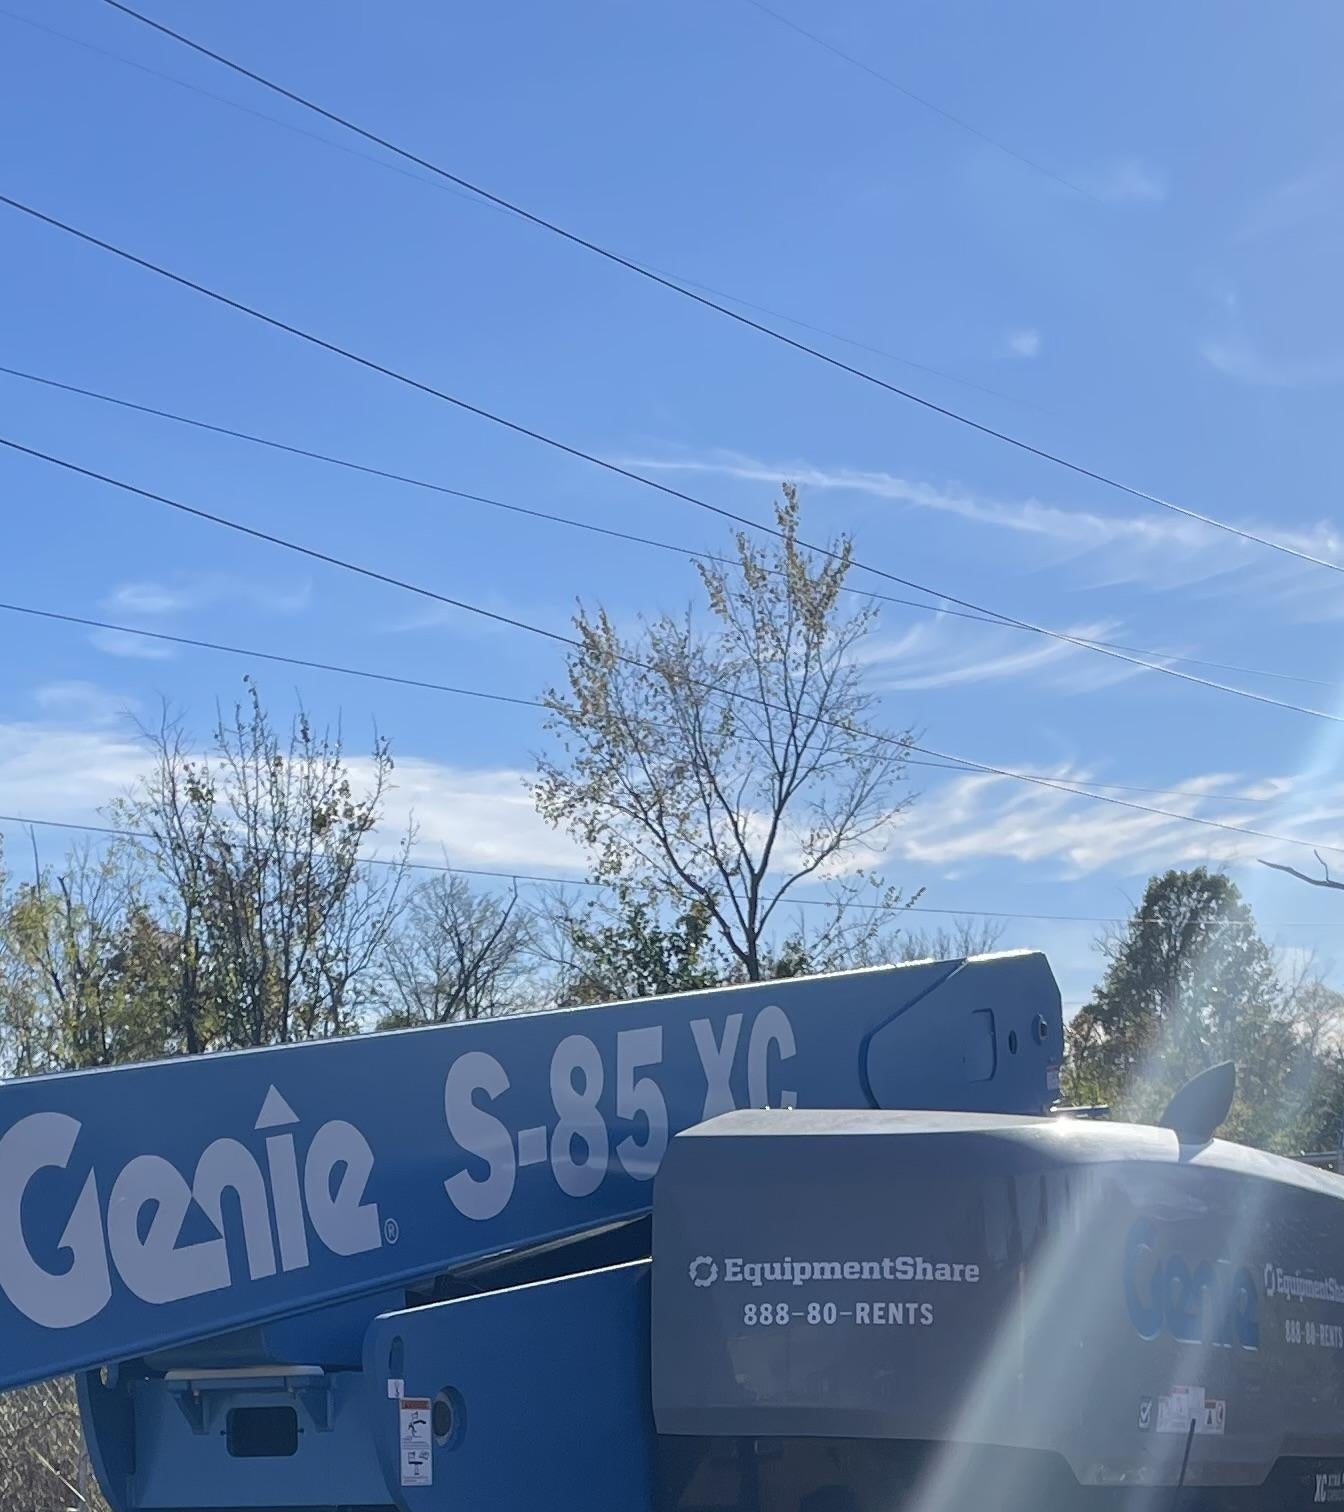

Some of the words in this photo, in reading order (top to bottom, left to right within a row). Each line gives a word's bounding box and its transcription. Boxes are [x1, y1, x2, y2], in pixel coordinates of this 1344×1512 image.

[444, 1030, 669, 1220] S-85
[690, 1005, 798, 1121] XC
[724, 1256, 981, 1286] EquipmentShare
[1124, 1217, 1260, 1351] Genie
[743, 1302, 934, 1325] 888-80-RENTS
[1284, 1319, 1344, 1349] 888-80-RENTS
